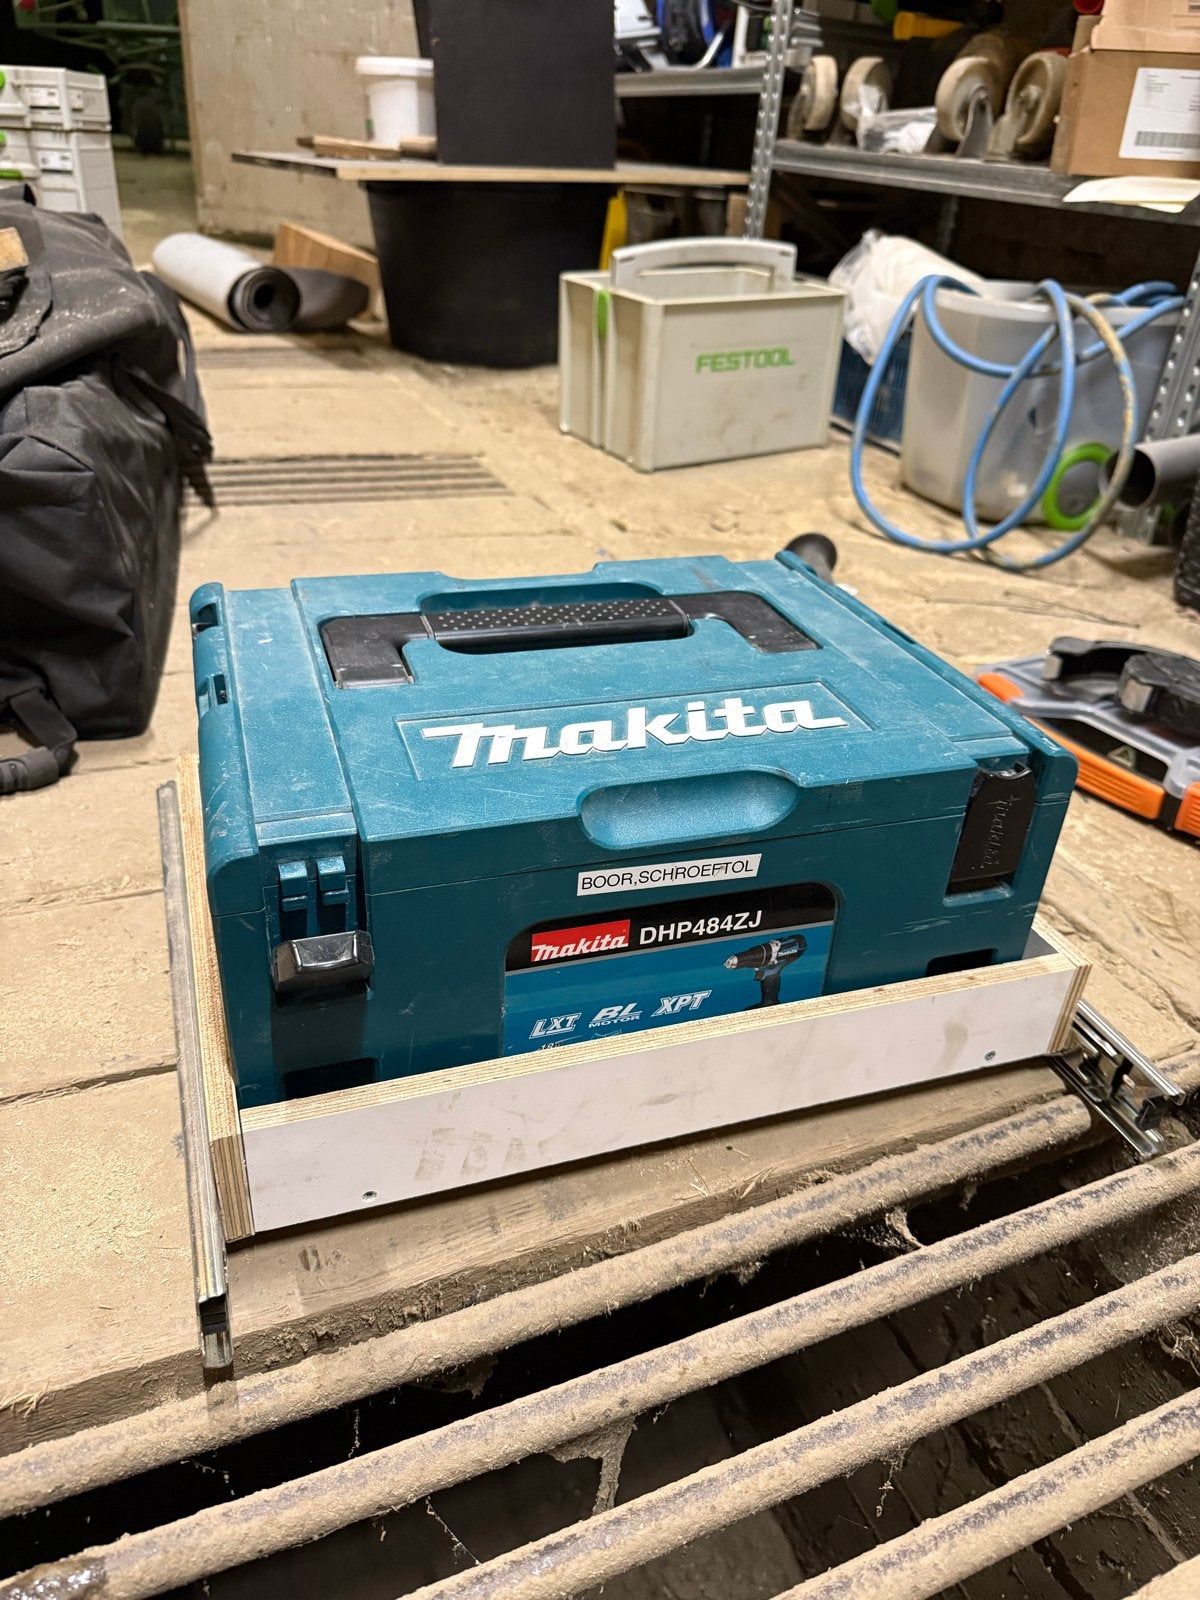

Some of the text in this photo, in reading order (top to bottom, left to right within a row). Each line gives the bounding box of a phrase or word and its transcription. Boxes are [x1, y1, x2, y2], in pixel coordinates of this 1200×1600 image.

[695, 347, 795, 374] FESTOOL
[421, 698, 848, 768] makita
[581, 860, 754, 889] BOOR,SCHROEFTOL
[531, 910, 762, 961] makita DHP484ZJ
[528, 1012, 582, 1040] LXT
[651, 989, 713, 1017] XPT
[588, 1015, 641, 1029] MOTOR
